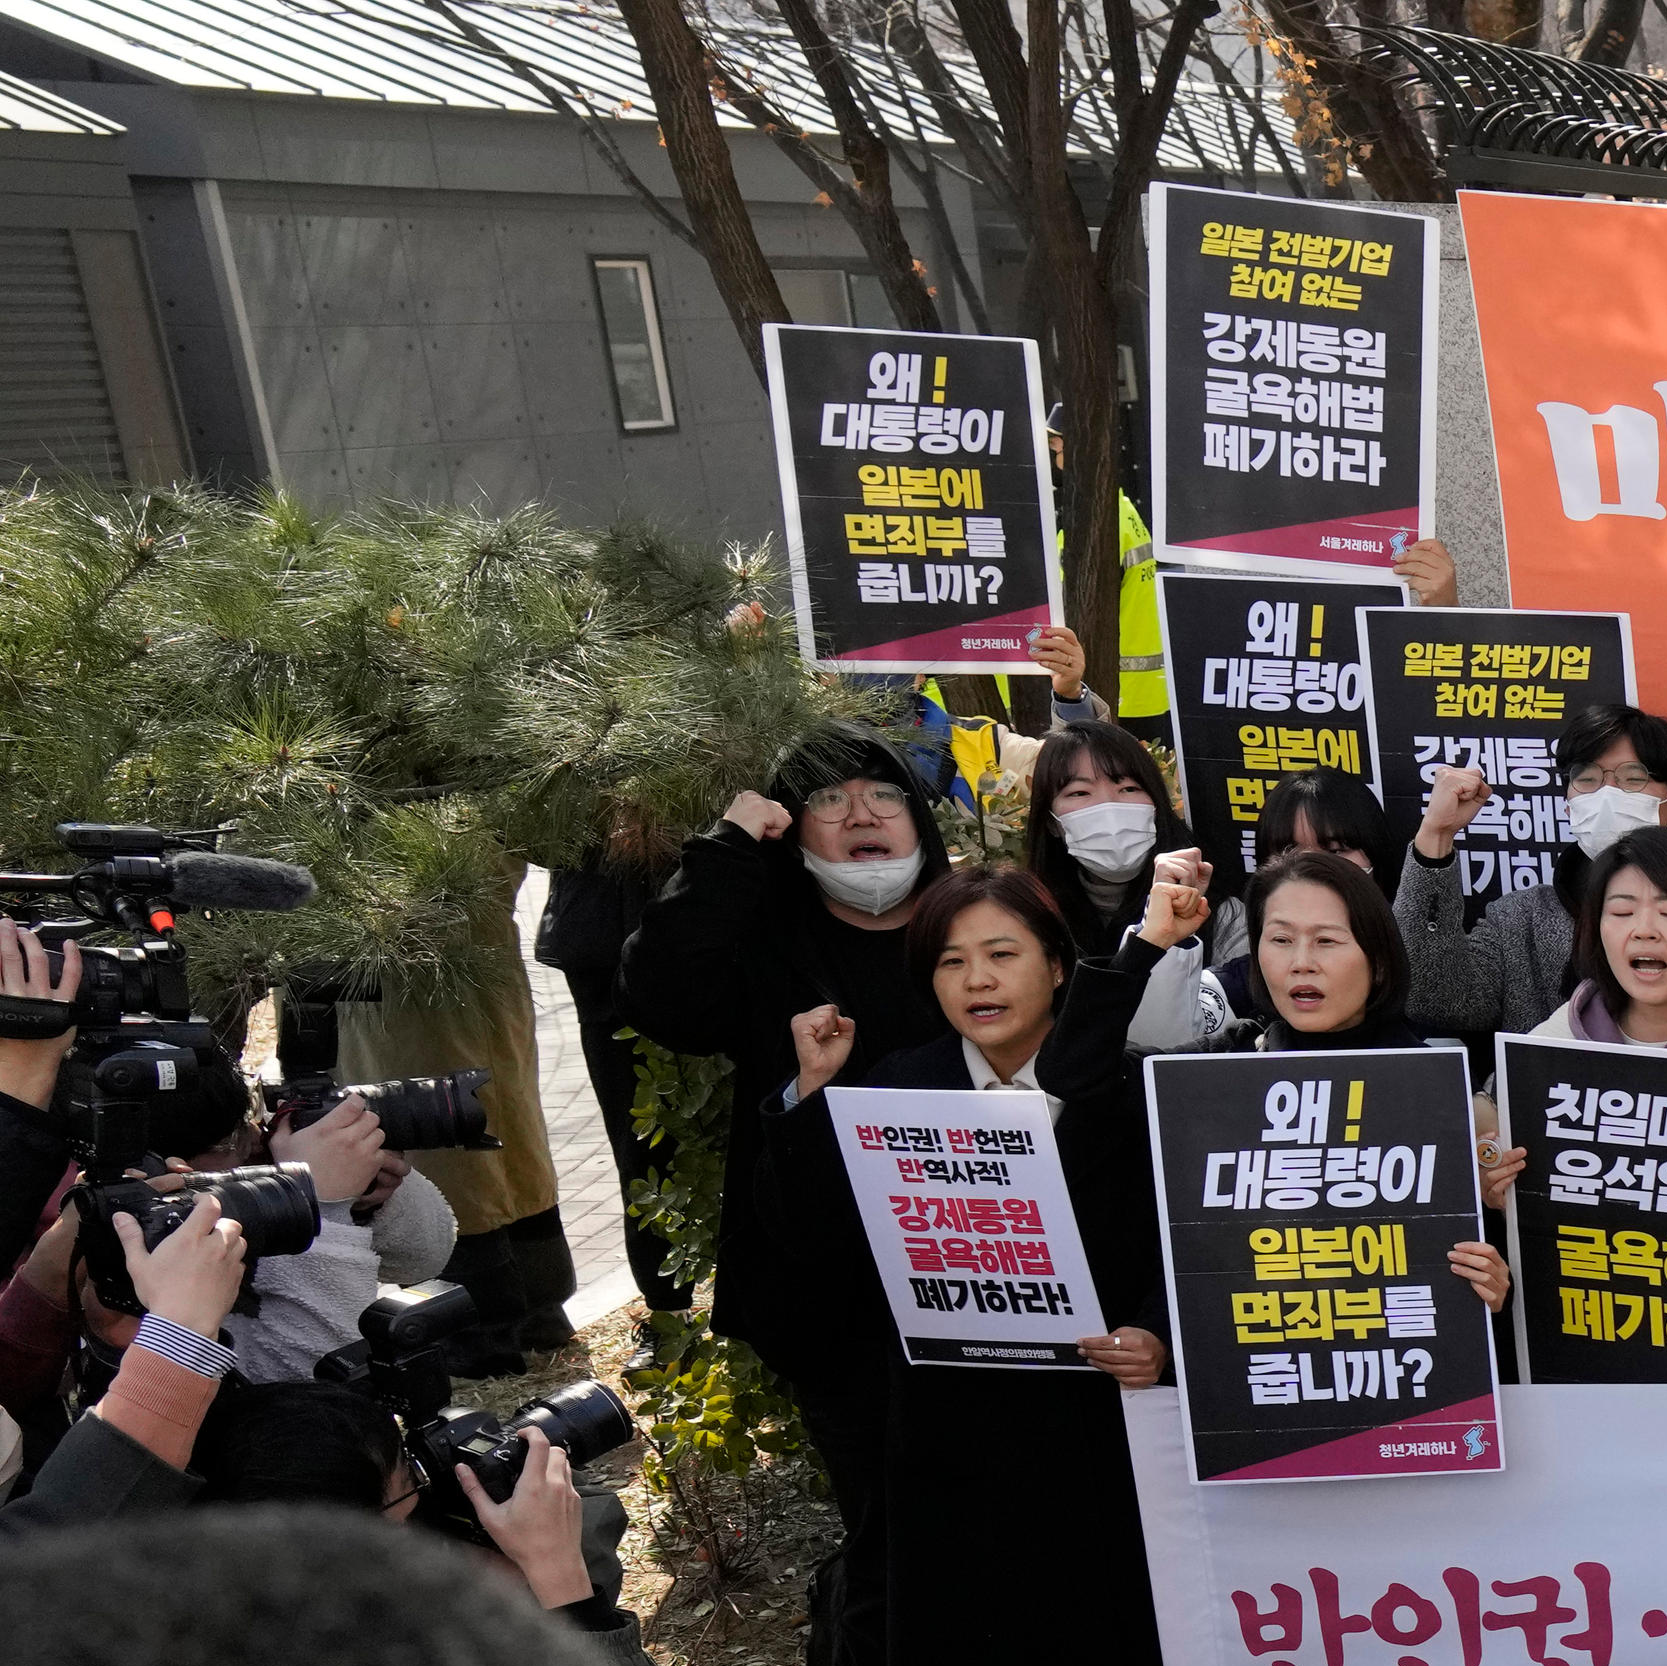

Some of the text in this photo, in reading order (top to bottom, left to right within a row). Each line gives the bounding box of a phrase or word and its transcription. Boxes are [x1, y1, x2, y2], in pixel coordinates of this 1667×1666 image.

[1201, 223, 1393, 278] 일본 전범기업
[1230, 264, 1361, 310] 참여 없는
[1203, 312, 1385, 378] 강제동원
[1204, 362, 1385, 434] 굴욕해법
[821, 403, 1004, 455] 대통령이
[1204, 423, 1386, 486] 폐기하라
[858, 465, 983, 509] 일본에
[845, 514, 1006, 557] 면죄부를
[1320, 536, 1383, 553] 서울겨레하나
[857, 563, 1003, 604] 줍니까?
[961, 638, 1021, 649] 청년겨레하나
[1405, 643, 1591, 680] 일본 전범기업
[1435, 683, 1564, 719] 참여 없는
[1239, 725, 1360, 774] 일본에
[1413, 736, 1562, 787] 강제동
[0, 1008, 44, 1024] ONY
[856, 1125, 1035, 1155] 반인권! 반헌법!
[897, 1158, 1011, 1185] 반역사적!
[1203, 1145, 1436, 1209] 대통령이
[889, 1196, 1045, 1234] 강제동원
[904, 1238, 1055, 1275] 굴욕해법
[1249, 1225, 1407, 1280] 일본에
[909, 1278, 1073, 1315] 폐기하라!
[1232, 1286, 1436, 1343] 면죄부를
[962, 1347, 1056, 1359] 한일역사정의평화행동
[1248, 1348, 1433, 1405] 줍니까?
[1379, 1441, 1456, 1457] 청년겨레하나
